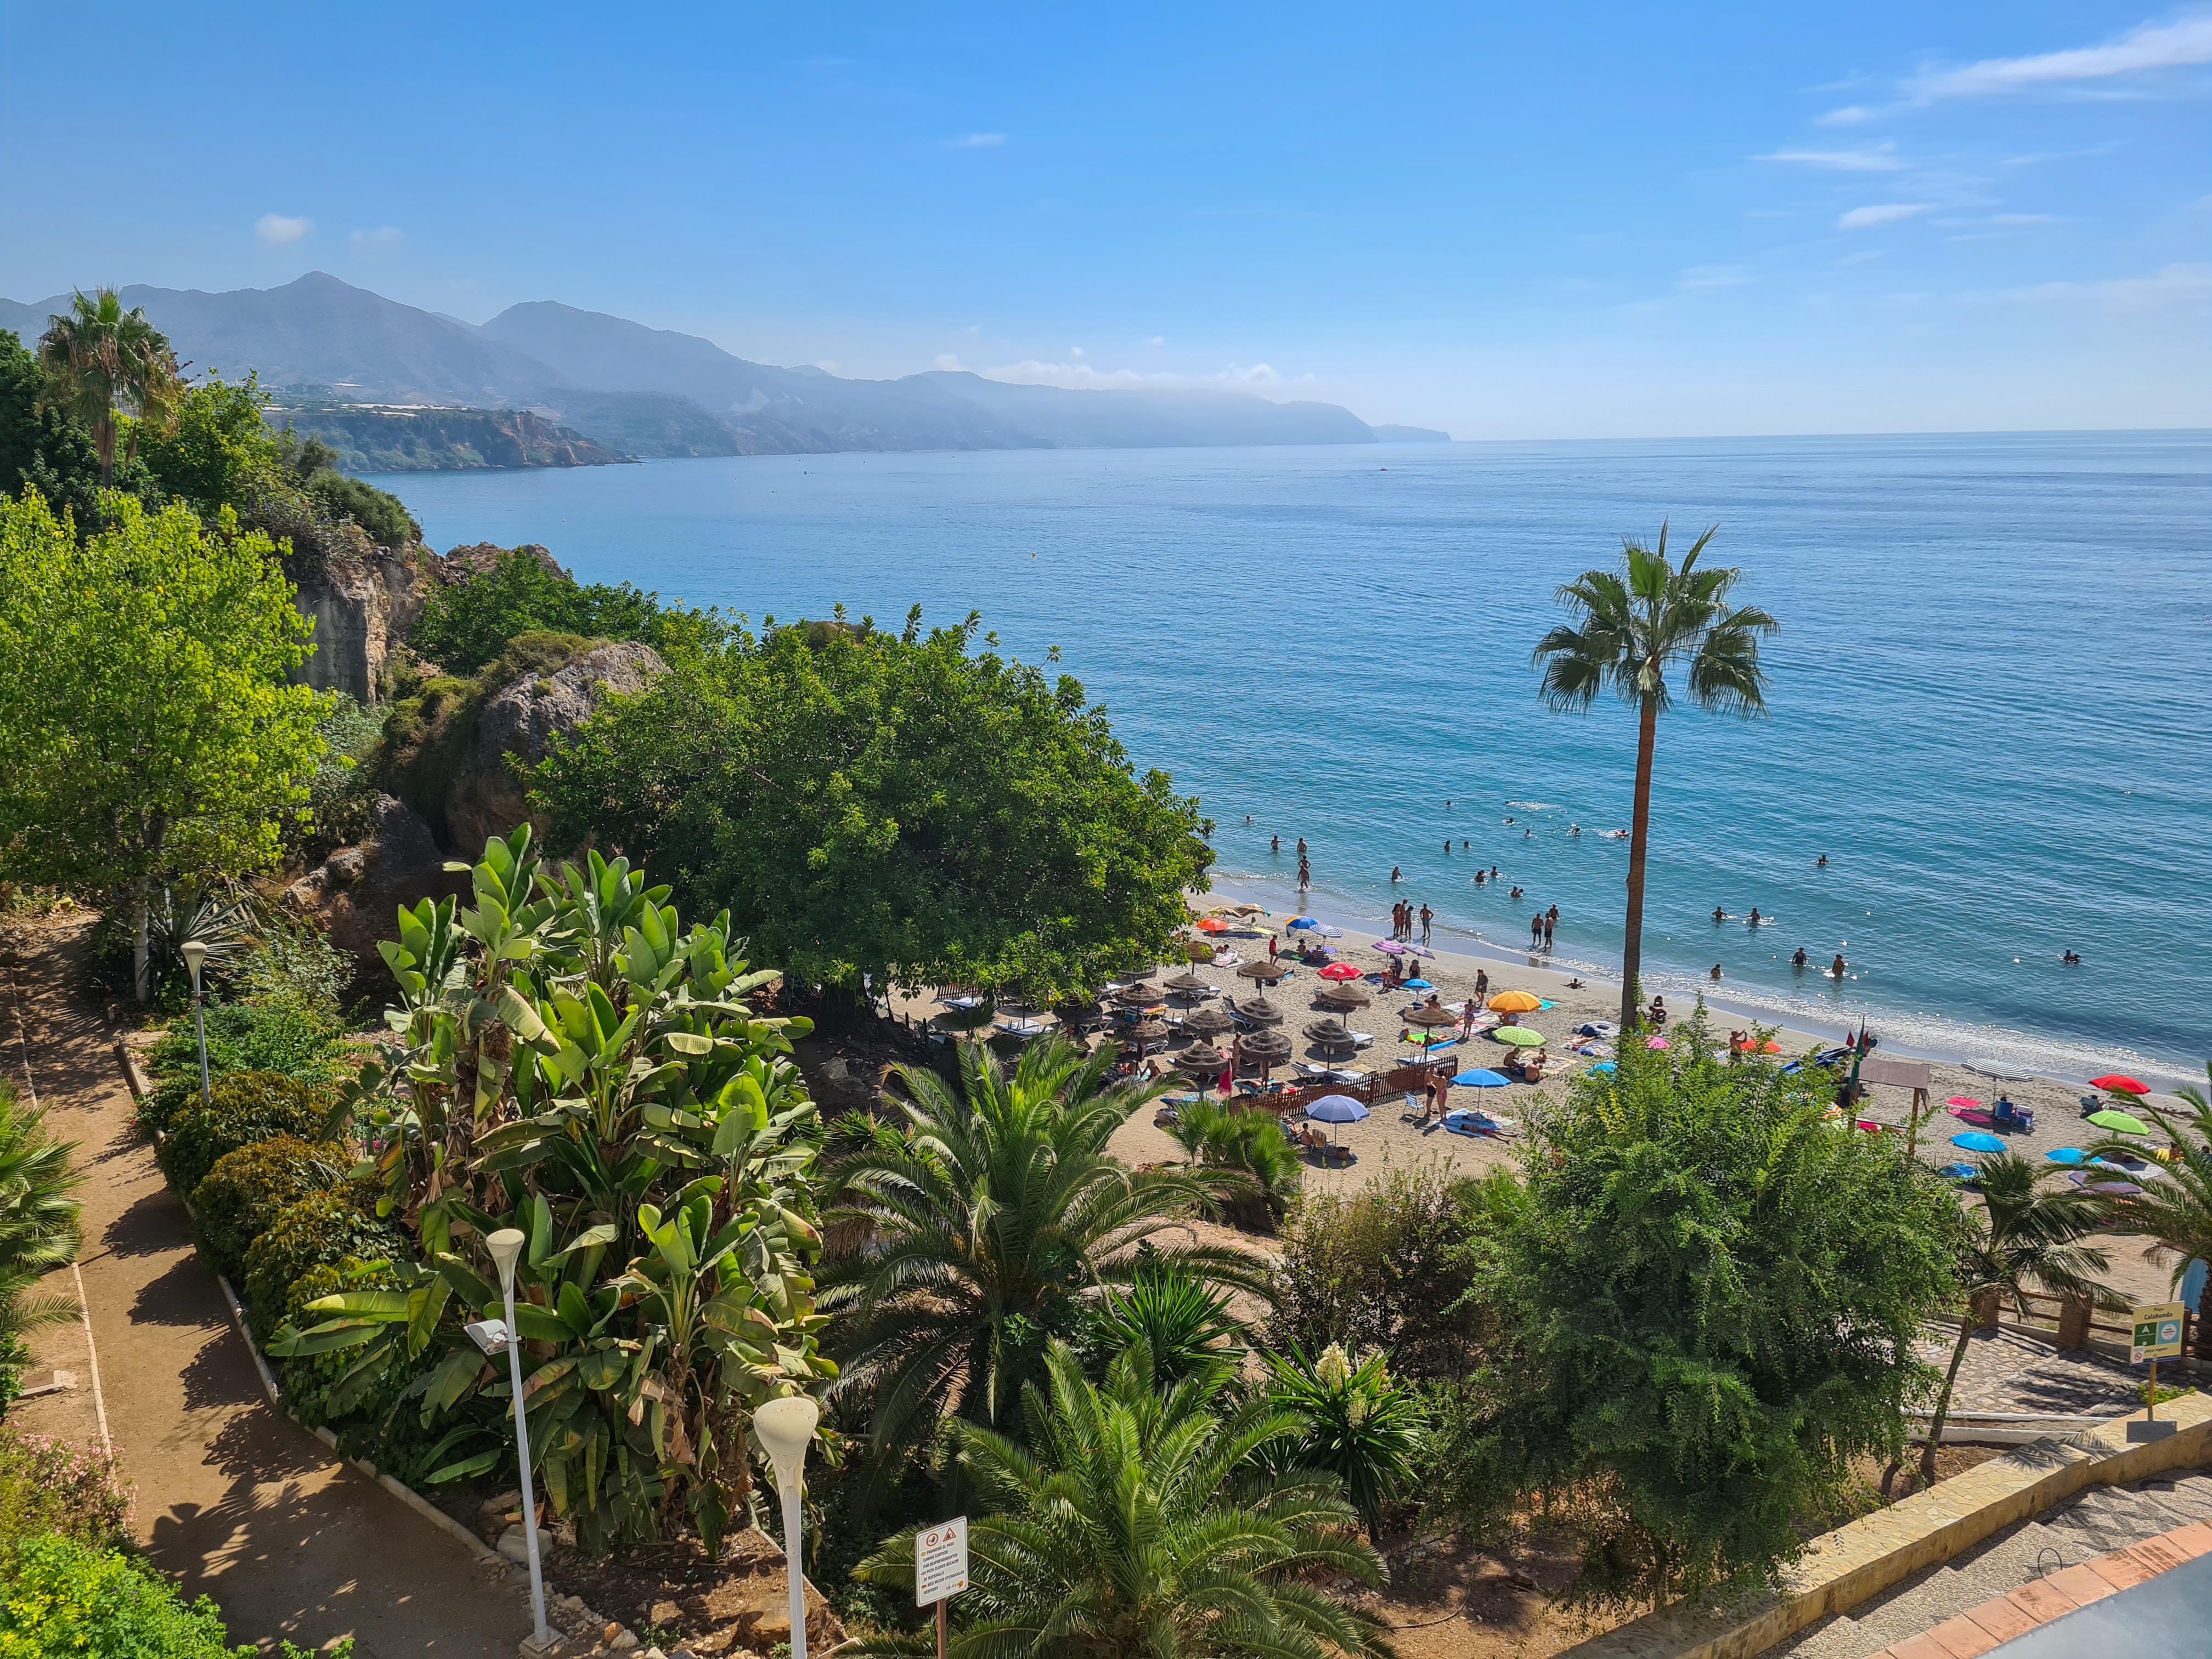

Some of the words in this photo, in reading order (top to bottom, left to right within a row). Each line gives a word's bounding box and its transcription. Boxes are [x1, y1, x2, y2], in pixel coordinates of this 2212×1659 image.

[2145, 1312, 2172, 1320] Calahonda
[928, 1571, 944, 1579] ROCKFALLS
[945, 1570, 964, 1580] STEINSCHLAG
[924, 1586, 939, 1594] GESPERRT
